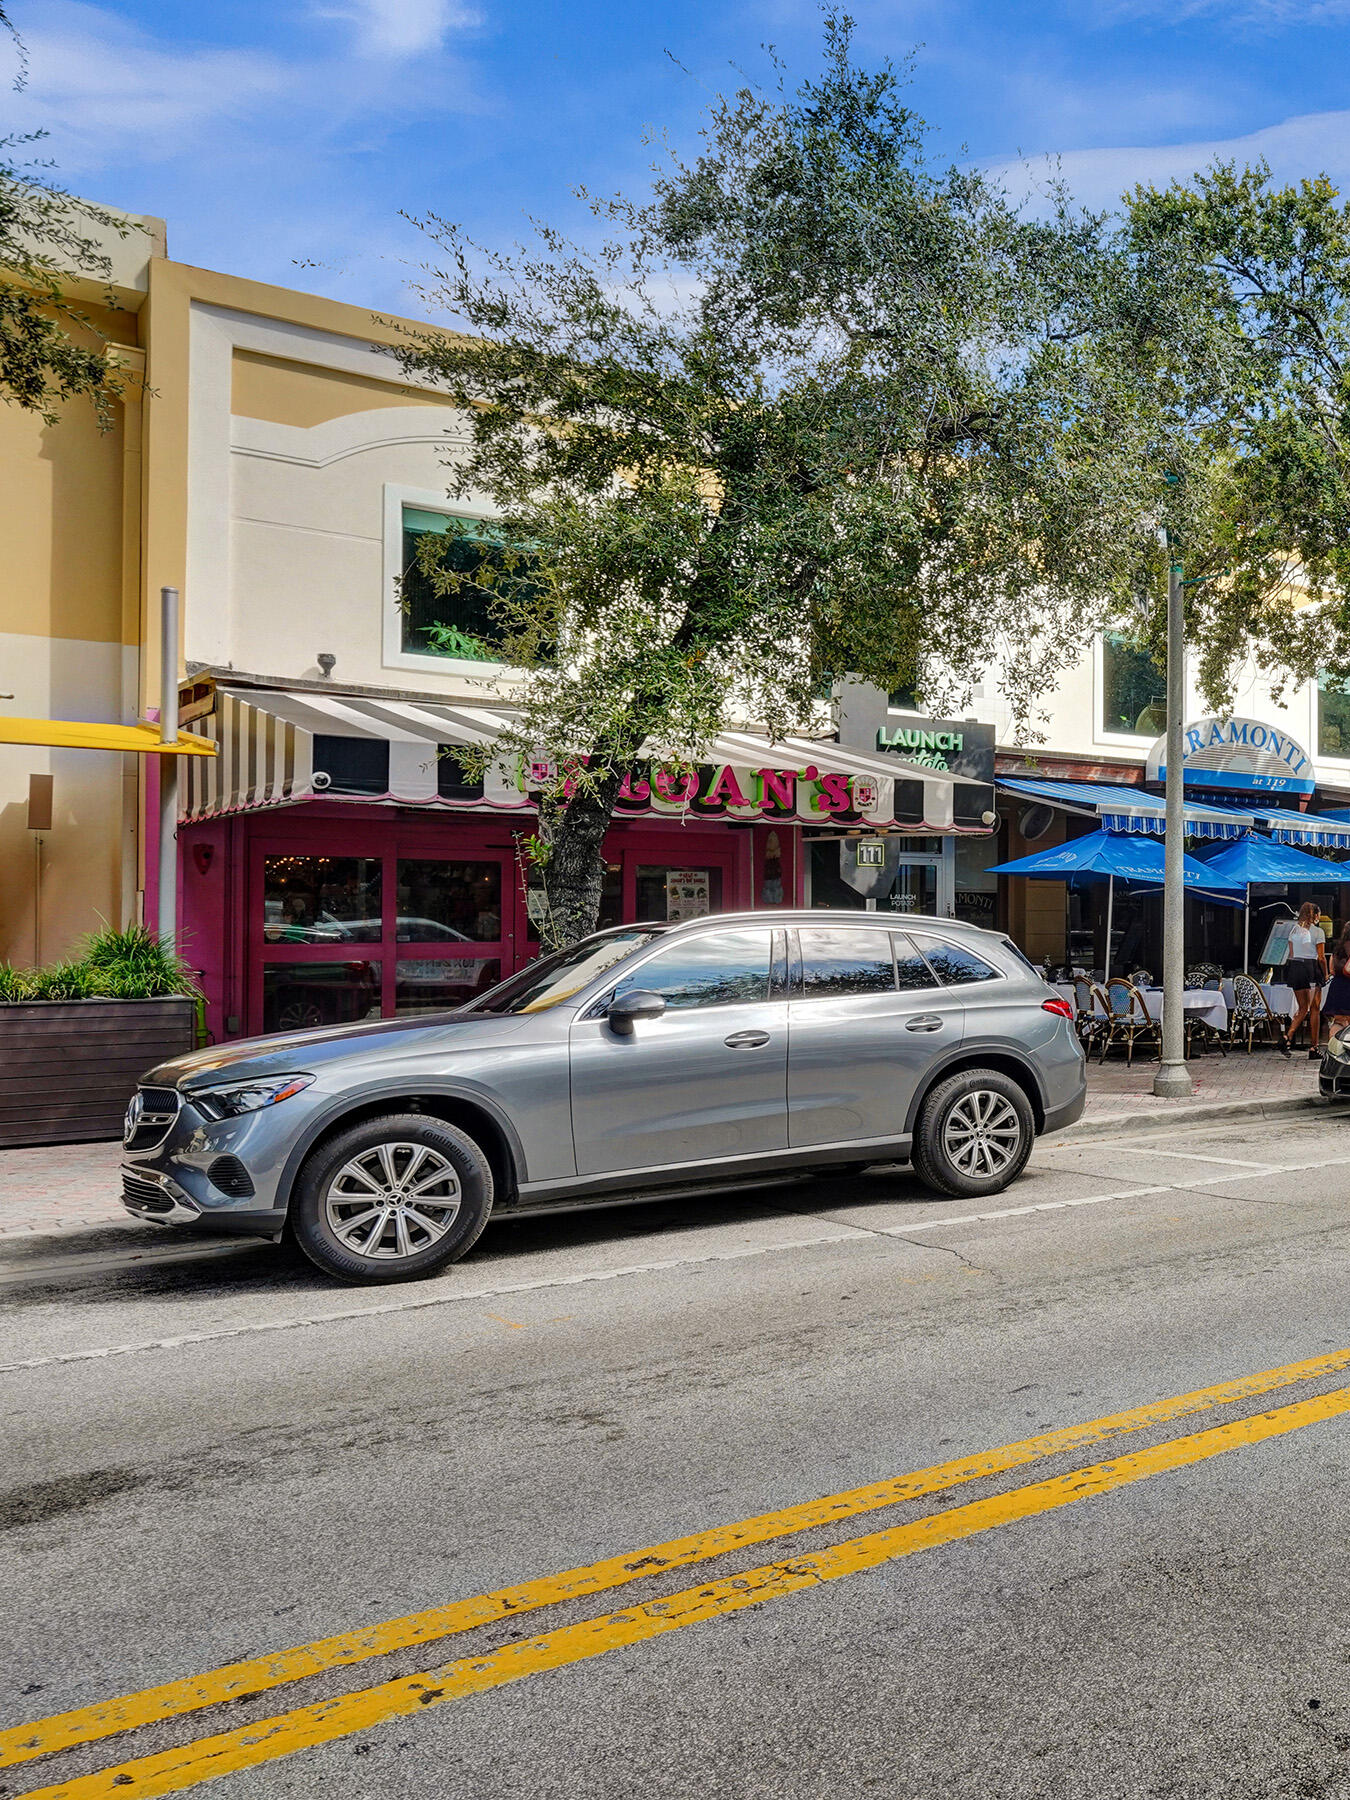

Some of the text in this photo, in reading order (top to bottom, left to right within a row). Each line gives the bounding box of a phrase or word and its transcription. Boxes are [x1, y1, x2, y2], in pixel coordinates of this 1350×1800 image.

[879, 726, 964, 751] LAUNCH
[1183, 722, 1307, 776] RAMONTI
[897, 749, 950, 773] otato
[860, 847, 881, 862] 111
[1116, 865, 1200, 880] TRAMOTI
[422, 1129, 472, 1168] Continental
